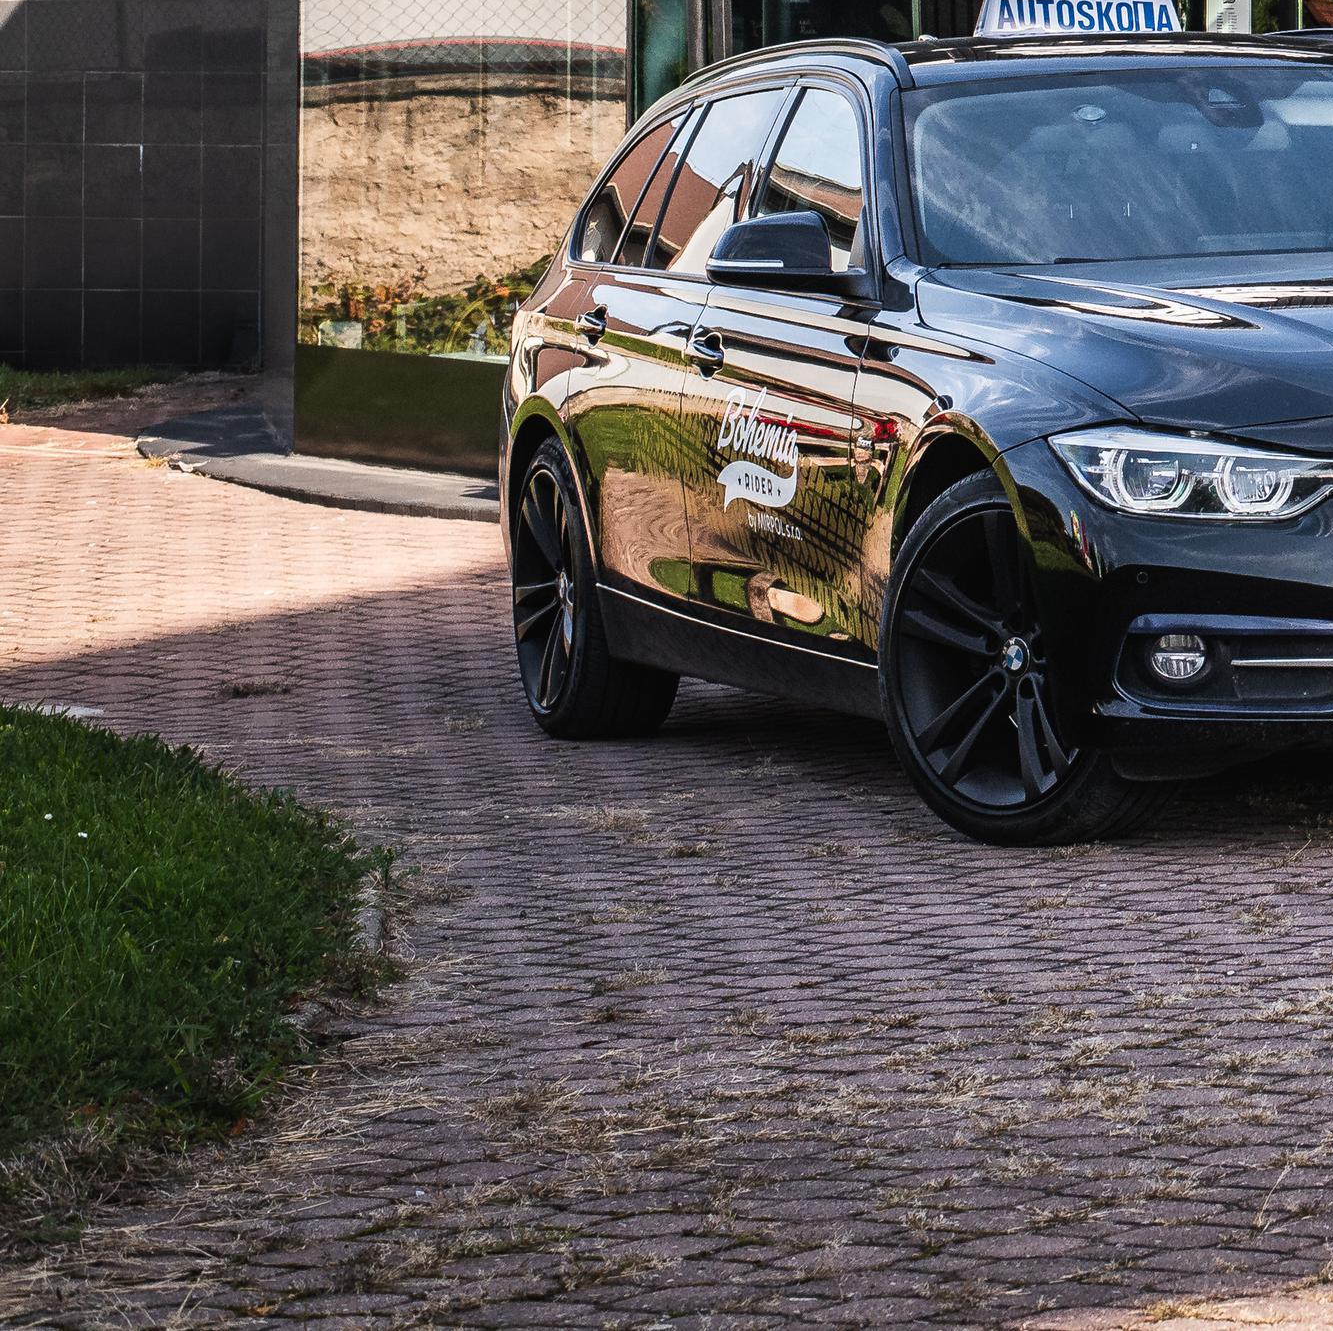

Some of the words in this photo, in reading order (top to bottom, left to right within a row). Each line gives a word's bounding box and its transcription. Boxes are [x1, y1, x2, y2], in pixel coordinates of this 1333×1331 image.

[717, 386, 799, 468] Bohemia
[744, 473, 773, 497] RIDER
[748, 509, 757, 532] by
[757, 512, 786, 537] MIRPOL
